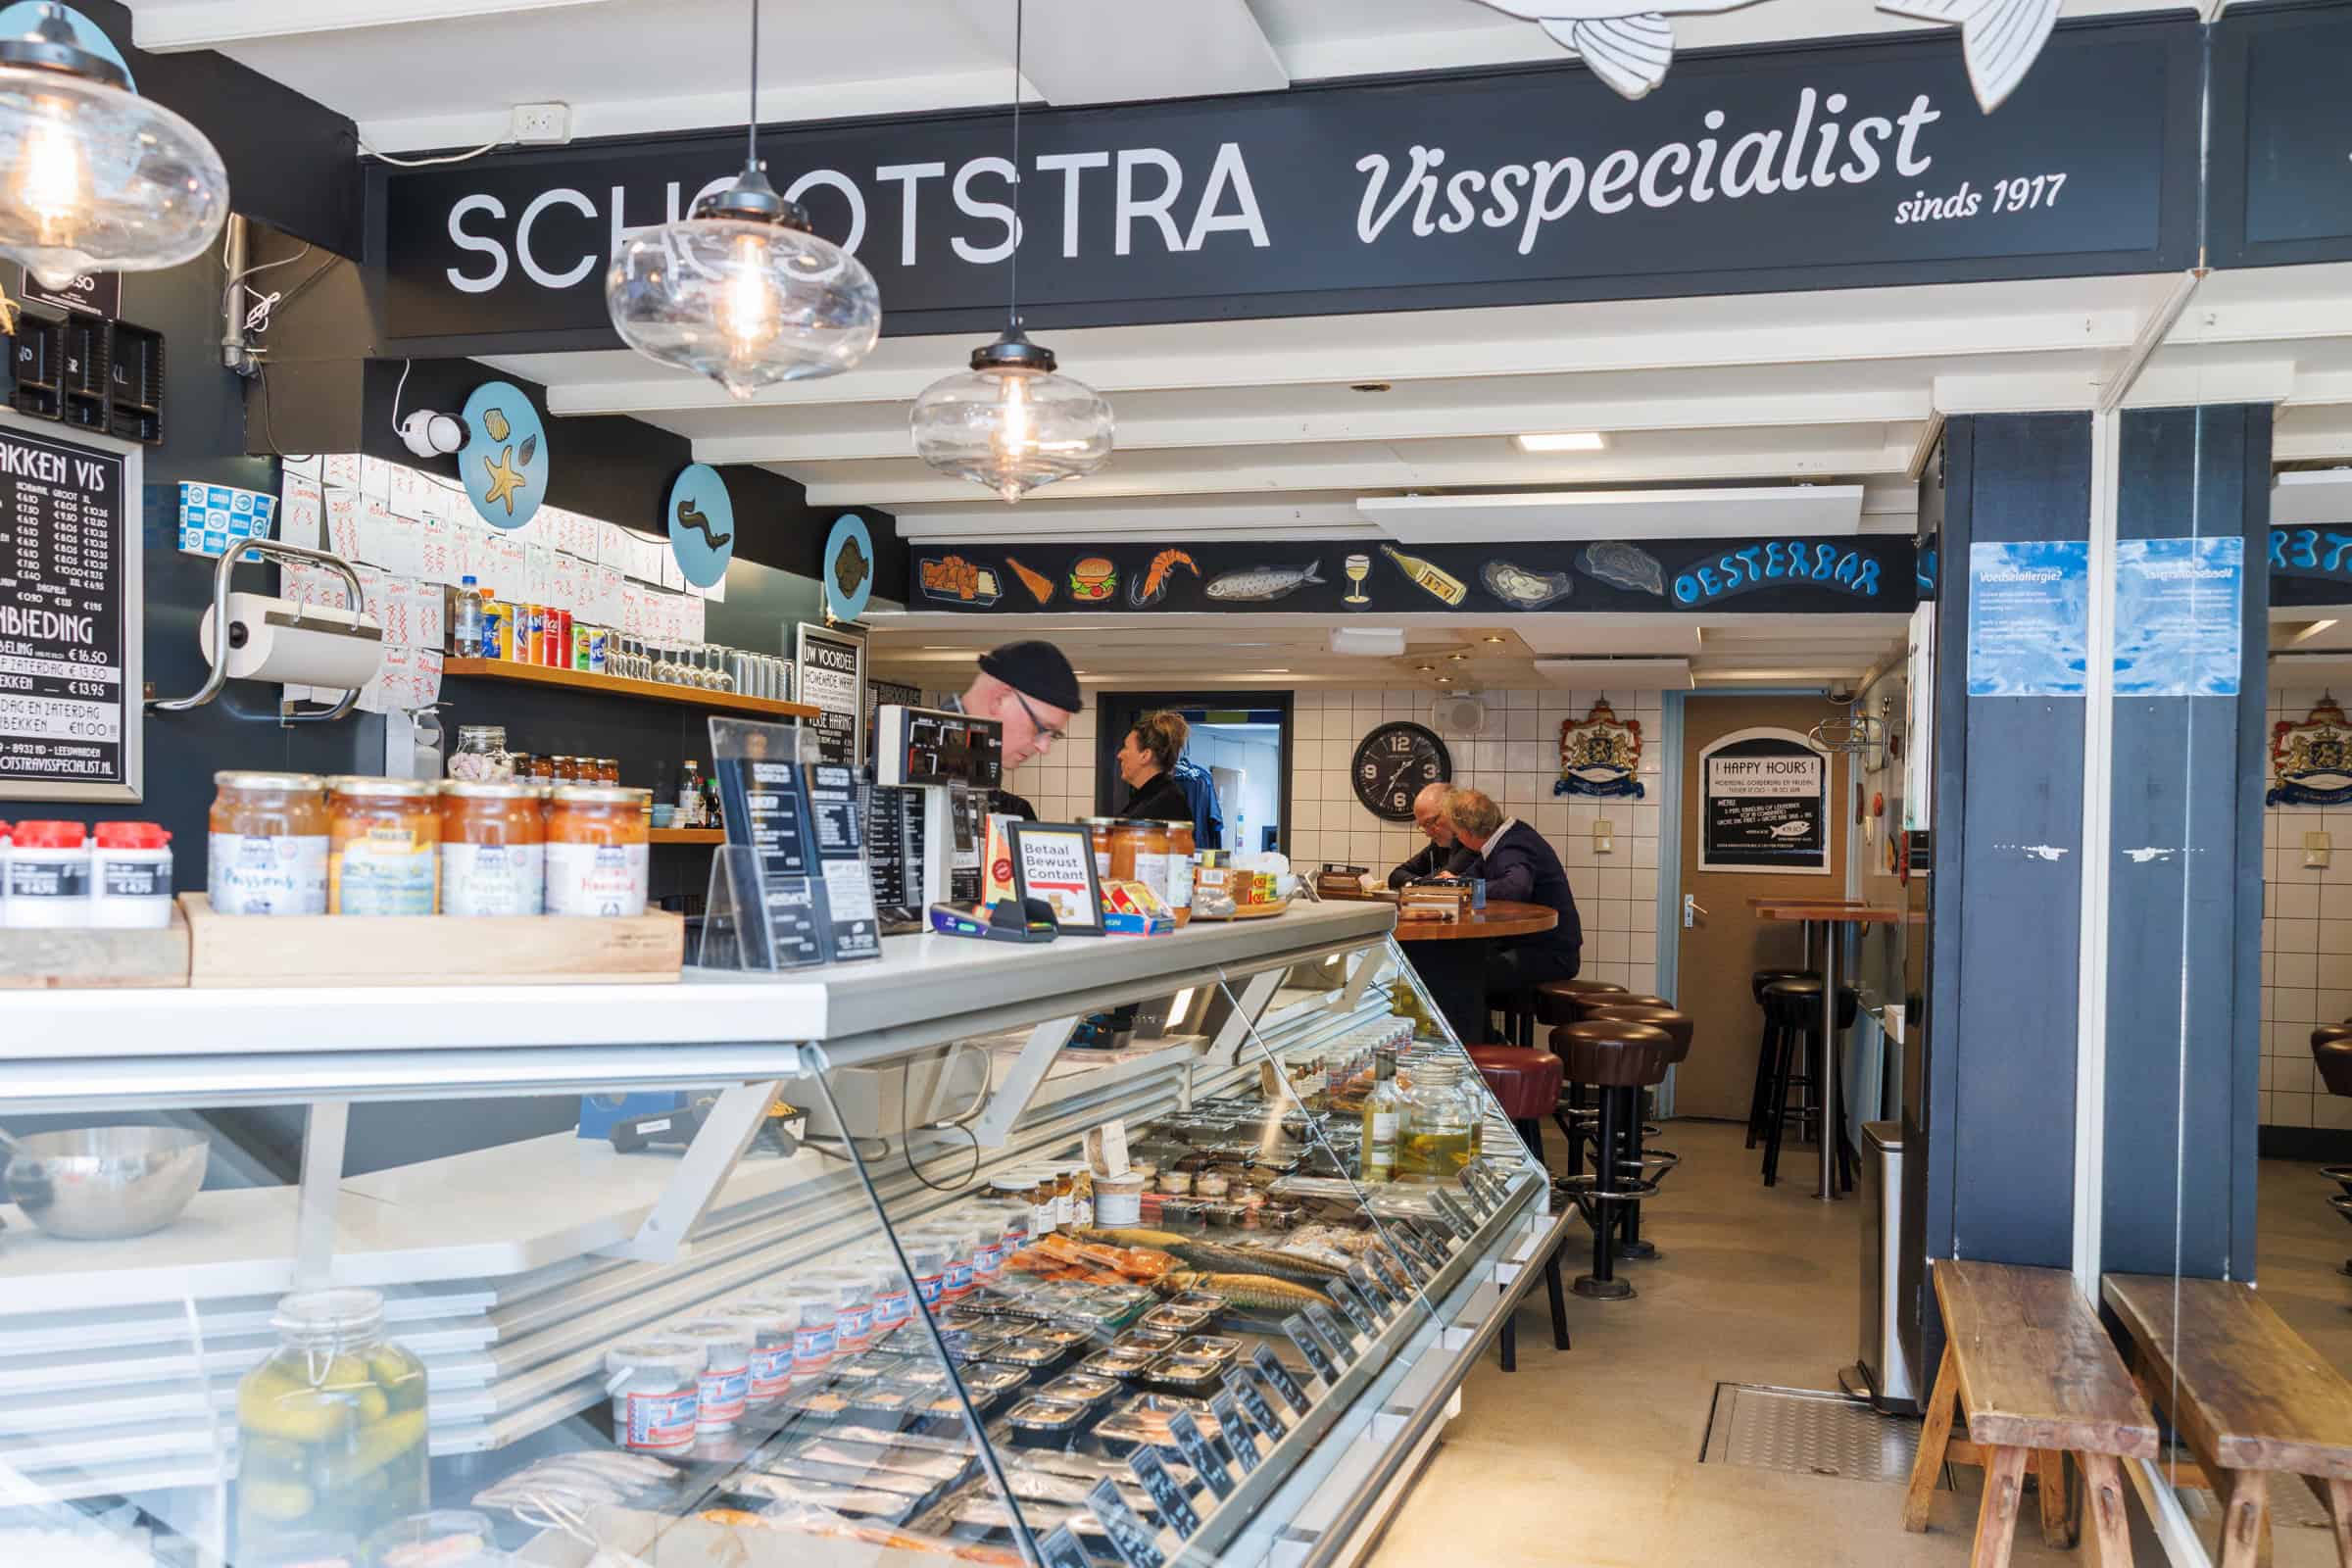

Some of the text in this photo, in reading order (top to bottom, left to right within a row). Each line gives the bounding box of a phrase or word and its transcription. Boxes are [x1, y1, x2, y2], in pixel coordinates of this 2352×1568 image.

[1354, 87, 1940, 254] Visspecialist
[1894, 173, 2067, 224] sinds 1917
[74, 459, 105, 492] VIS
[1675, 541, 1881, 603] OESTERBAR
[1391, 736, 1410, 752] 12
[1364, 764, 1377, 779] 9
[1423, 764, 1437, 779] 3
[1723, 761, 1761, 774] HAPPY
[1766, 761, 1807, 774] HOURS
[1394, 792, 1406, 808] 6
[1025, 844, 1069, 856] Betaal
[1026, 856, 1078, 867] Bewust
[1028, 868, 1083, 880] Contant
